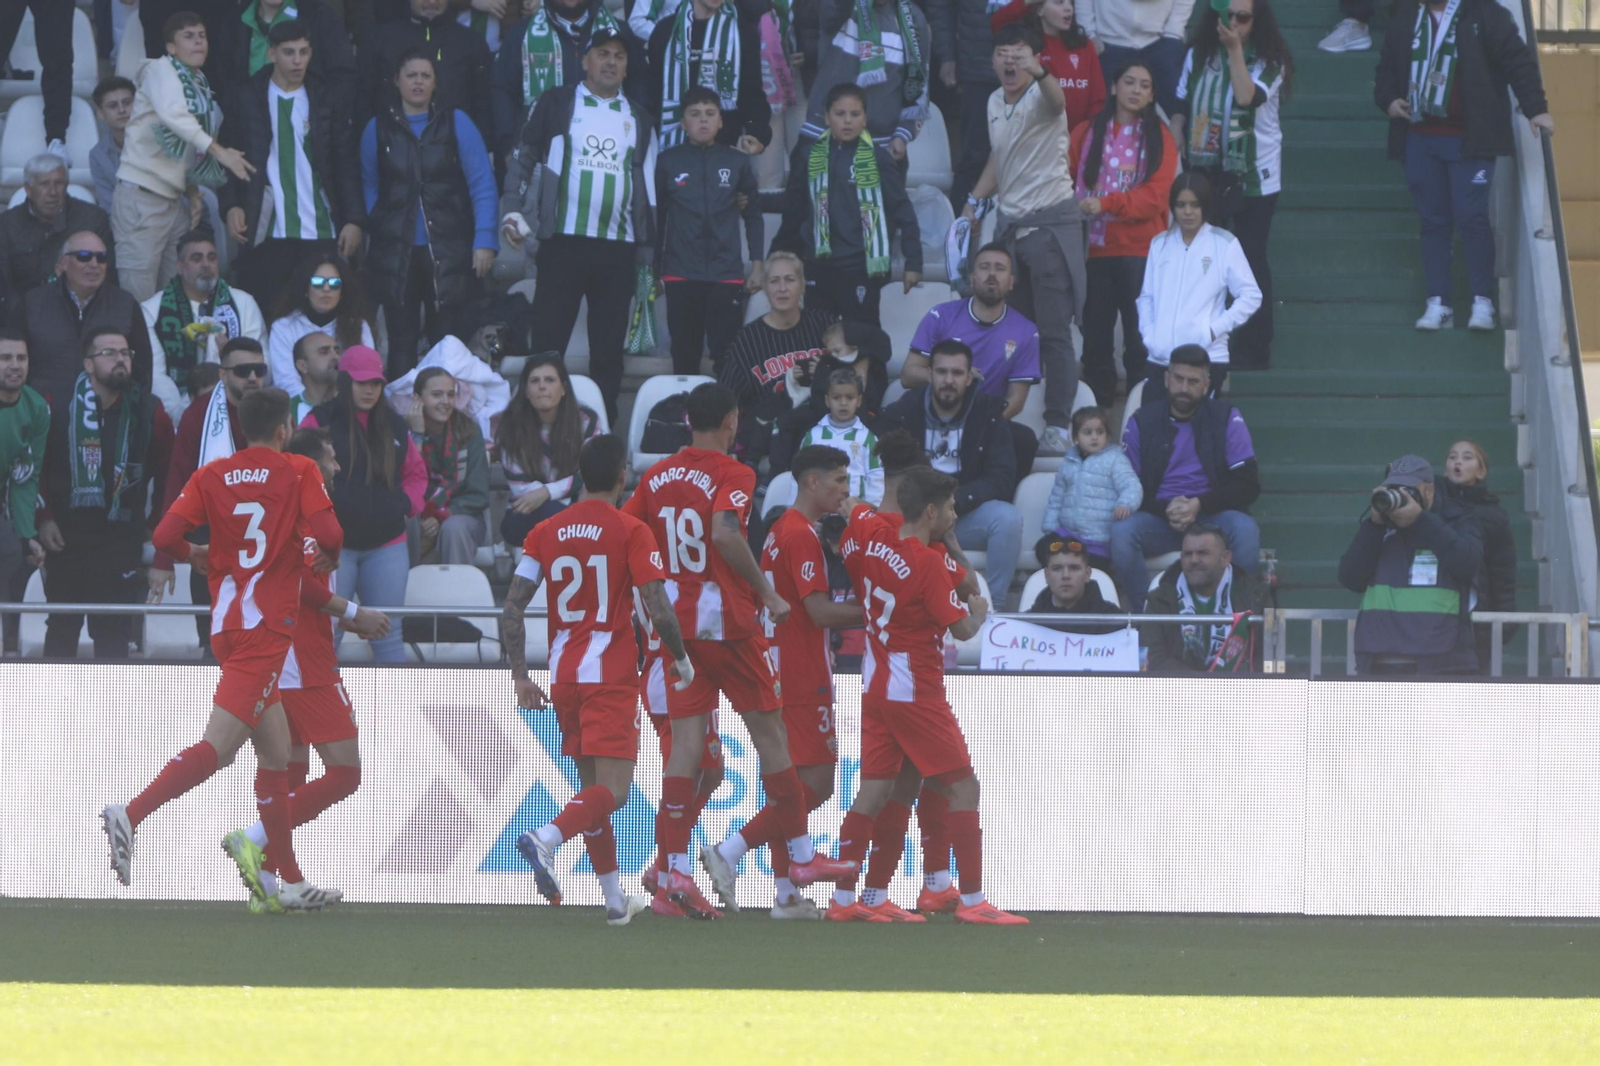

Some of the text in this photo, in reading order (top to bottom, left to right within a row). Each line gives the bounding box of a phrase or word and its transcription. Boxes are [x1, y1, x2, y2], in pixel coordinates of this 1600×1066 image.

[577, 158, 620, 172] SILBON
[224, 468, 270, 486] EDGAR
[648, 466, 686, 494] MARC
[232, 501, 267, 569] 3
[557, 523, 603, 543] CHUMI
[657, 506, 707, 575] 18
[550, 554, 609, 623] 21
[863, 575, 896, 646] 17
[262, 671, 277, 698] 3
